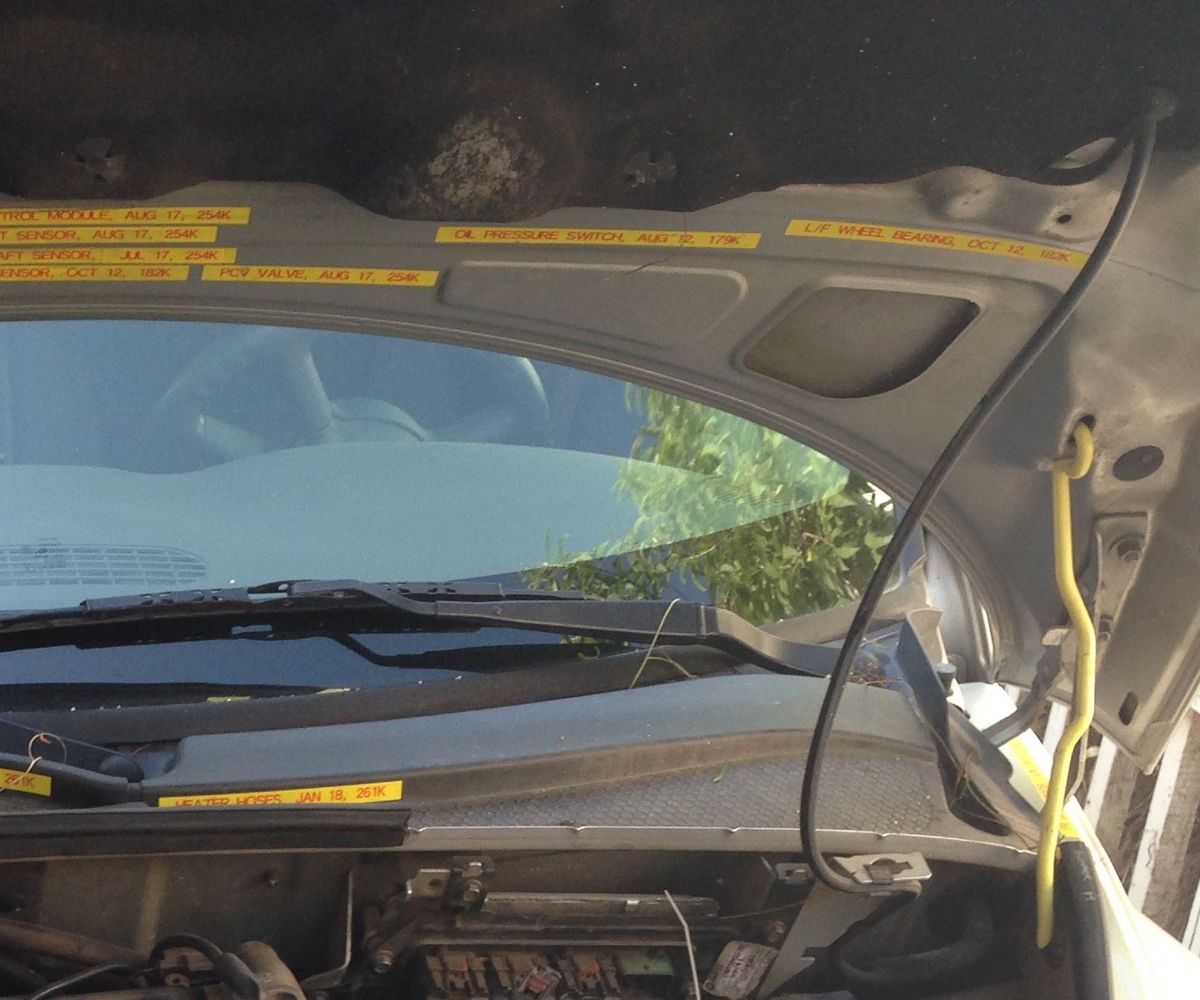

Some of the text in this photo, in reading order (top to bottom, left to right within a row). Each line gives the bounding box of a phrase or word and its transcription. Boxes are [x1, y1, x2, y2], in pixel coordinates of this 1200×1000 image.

[47, 210, 113, 222] MODULE,
[125, 210, 157, 220] AUG
[197, 209, 231, 220] 254K
[17, 230, 81, 242] SENSOR,
[92, 230, 125, 240] AUG
[164, 229, 198, 239] 254K
[484, 231, 559, 240] PRESSURE
[637, 233, 667, 243] AUG
[803, 223, 831, 234] L/F
[838, 226, 884, 238] WHEEL
[967, 239, 1000, 251] OCT
[185, 250, 218, 260] 254K
[65, 267, 98, 278] OCT
[220, 269, 421, 282] PCV VALVE, AUG 17, 254K
[296, 793, 320, 803] JAN
[330, 790, 346, 802] 18,
[357, 786, 386, 799] 261K
